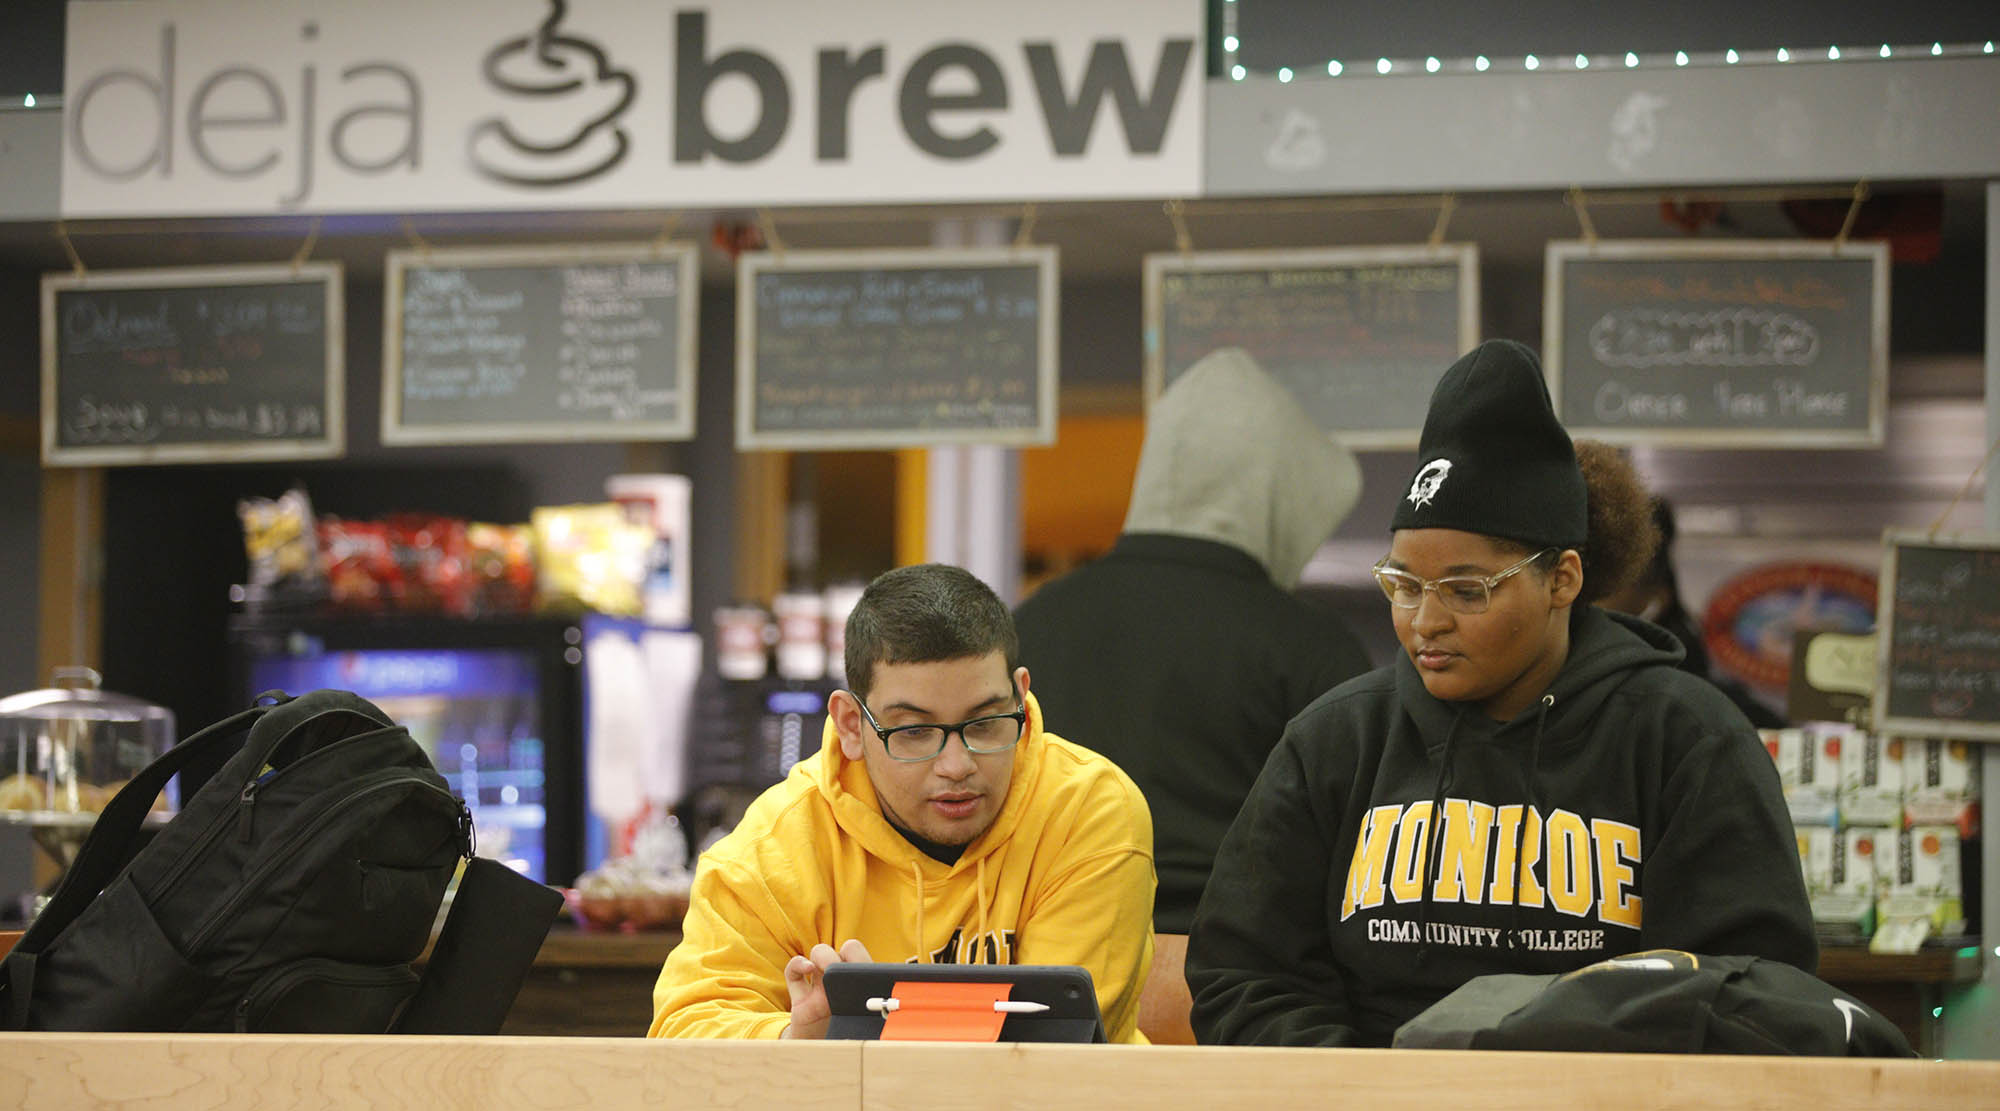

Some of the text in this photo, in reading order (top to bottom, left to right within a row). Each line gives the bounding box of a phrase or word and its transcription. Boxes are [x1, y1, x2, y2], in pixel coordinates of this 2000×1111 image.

[68, 10, 1197, 210] deja brew
[1340, 797, 1643, 930] MONROE
[1368, 918, 1502, 948] COMMUNITY
